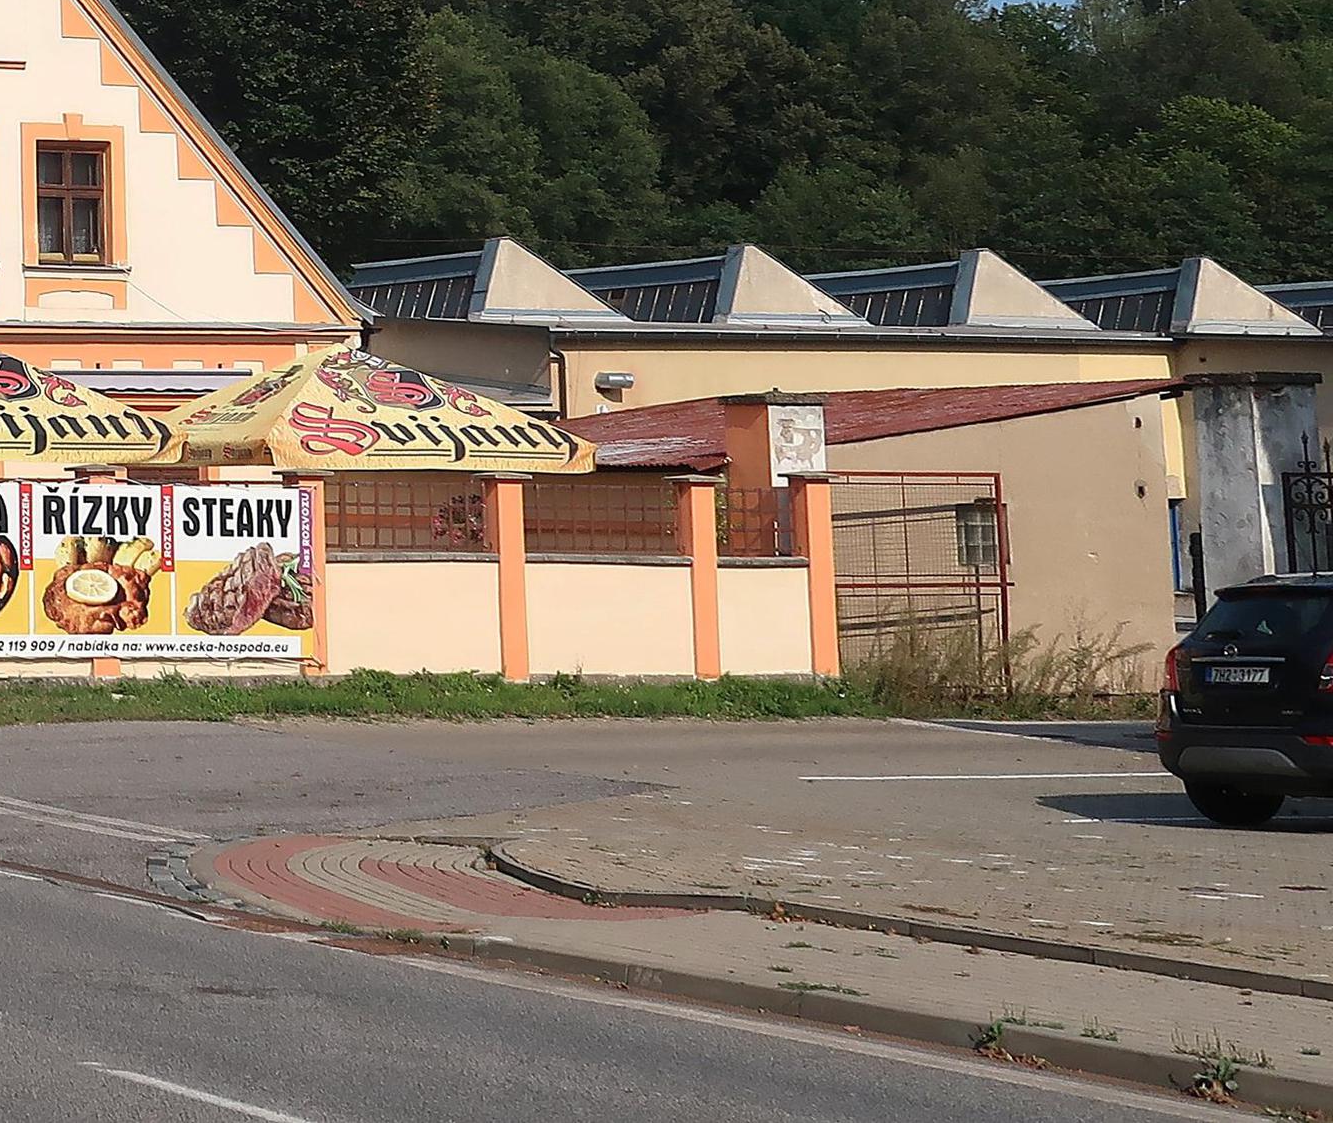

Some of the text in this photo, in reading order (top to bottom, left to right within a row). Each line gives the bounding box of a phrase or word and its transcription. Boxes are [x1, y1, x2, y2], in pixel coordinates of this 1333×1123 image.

[289, 402, 578, 465] Svijany
[22, 492, 30, 557] ROZVOZEM
[43, 486, 152, 535] ŘÍZKY
[163, 495, 171, 559] ROZVOZEM
[183, 497, 292, 538] STEAKY
[301, 493, 310, 568] bez ROZVOZU
[8, 641, 27, 652] 119
[30, 641, 55, 652] 909
[58, 640, 66, 653] /
[67, 640, 119, 652] nabídka
[122, 642, 142, 652] na:
[146, 641, 289, 654] www.ceska-hospoda.eu
